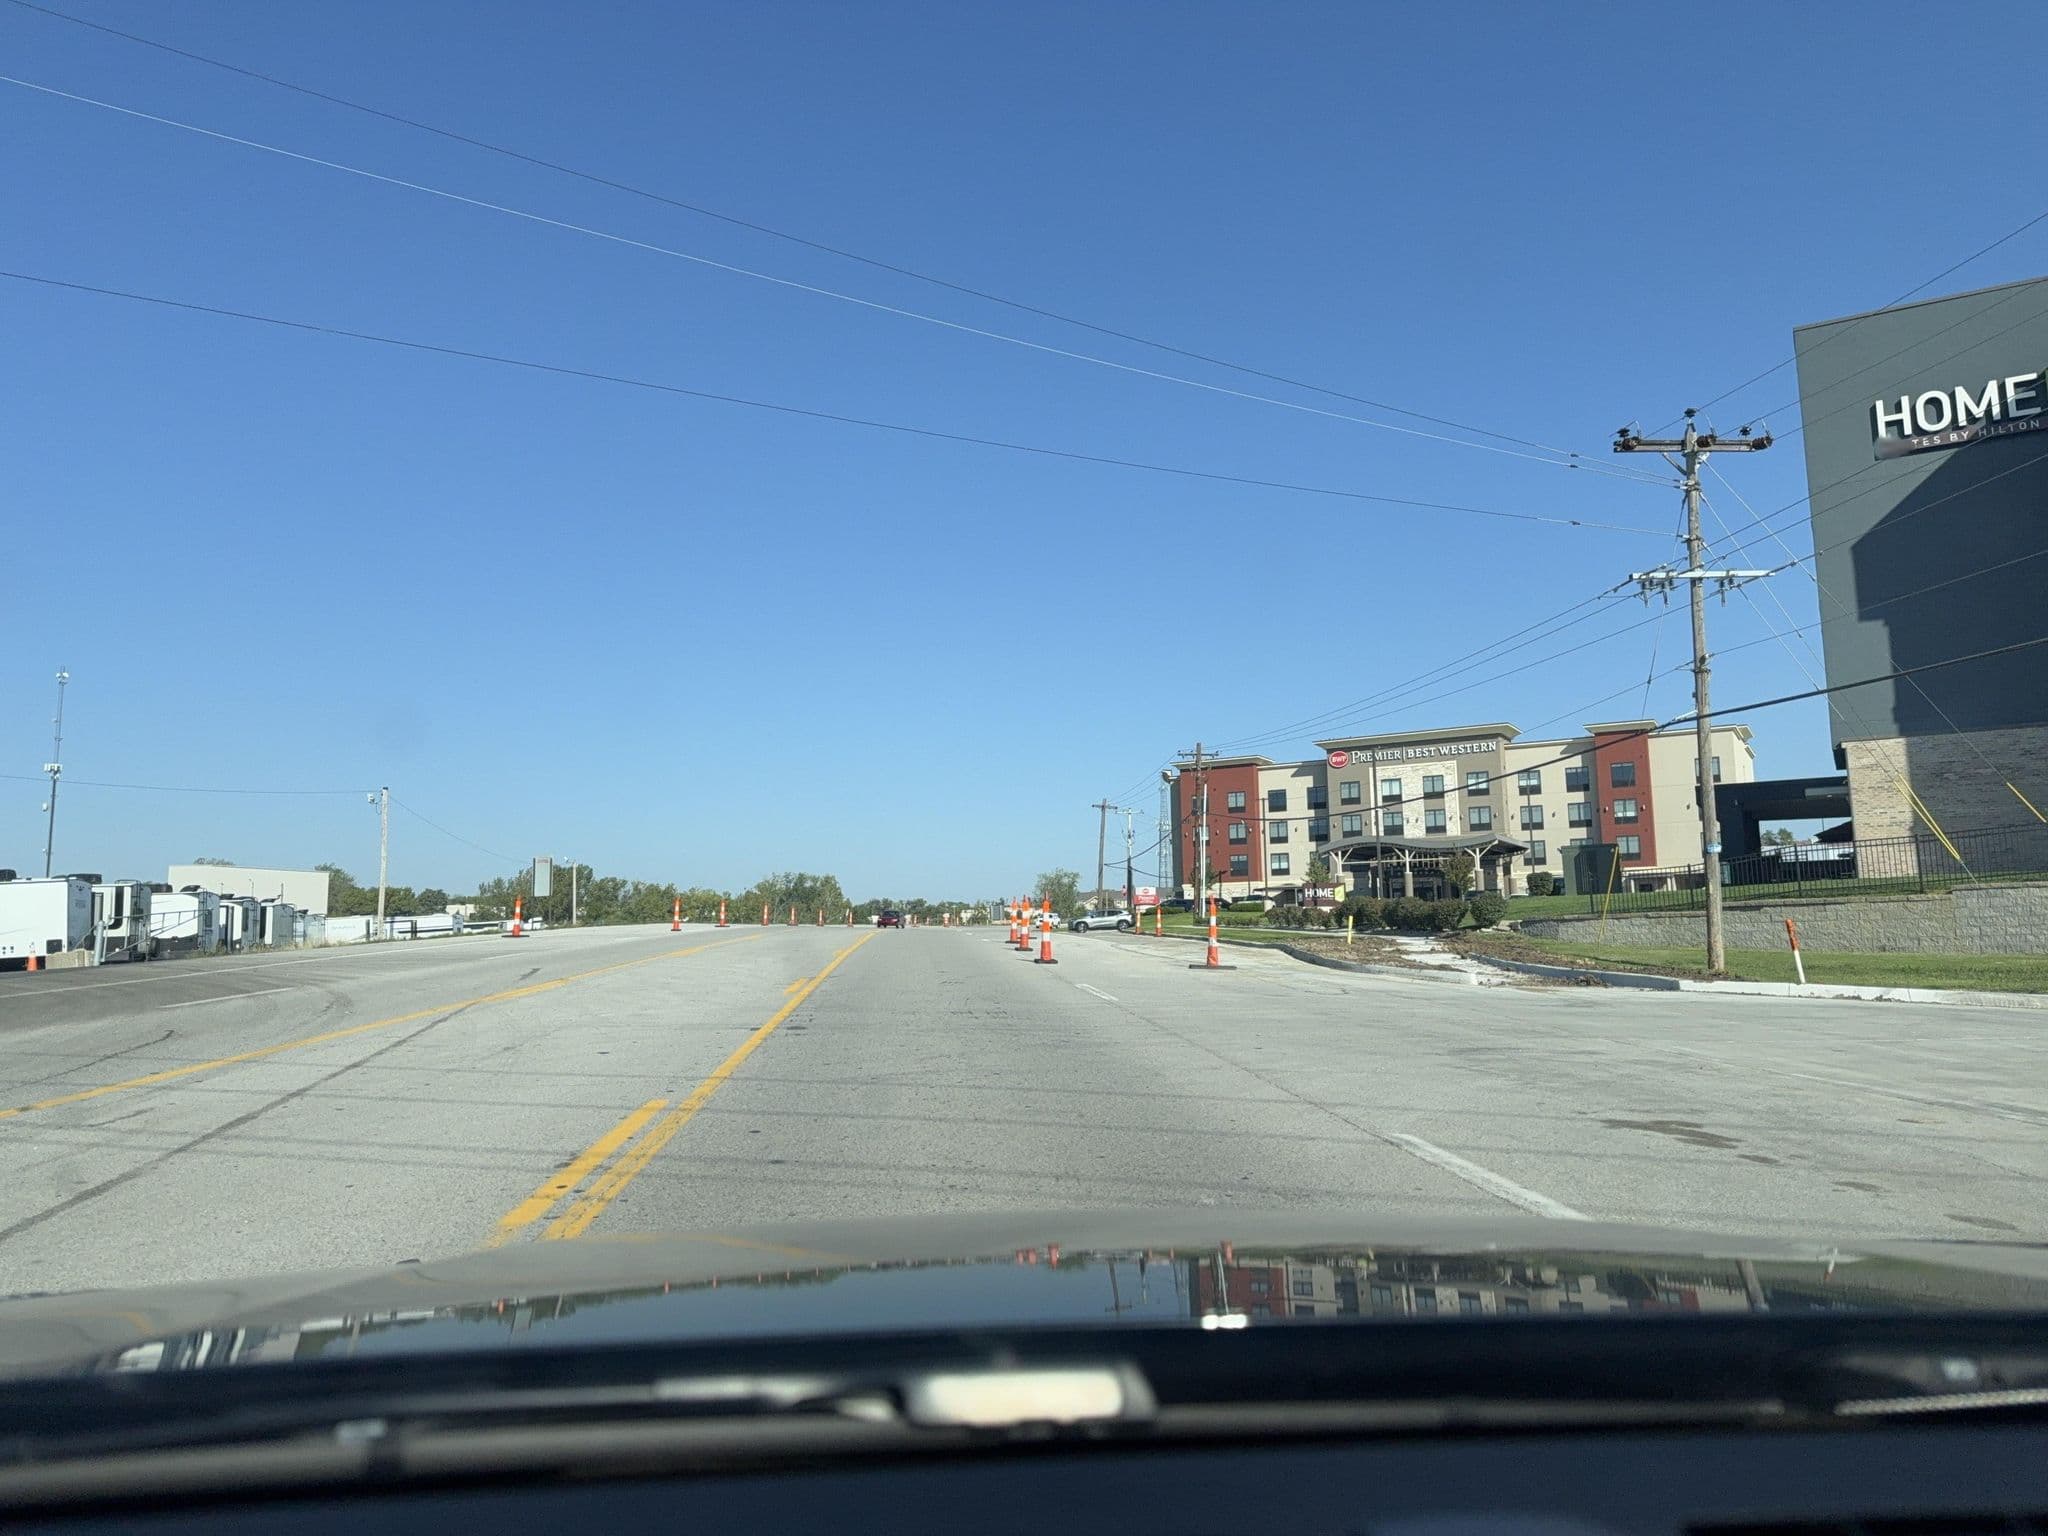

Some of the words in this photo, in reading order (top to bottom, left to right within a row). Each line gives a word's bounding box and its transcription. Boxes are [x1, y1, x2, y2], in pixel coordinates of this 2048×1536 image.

[1875, 372, 2042, 439] HOME
[1949, 430, 1969, 442] BY
[1978, 419, 2041, 438] HILTON
[1407, 747, 1436, 759] BEST
[1439, 742, 1496, 755] WESTERN
[1305, 887, 1334, 898] HOME
